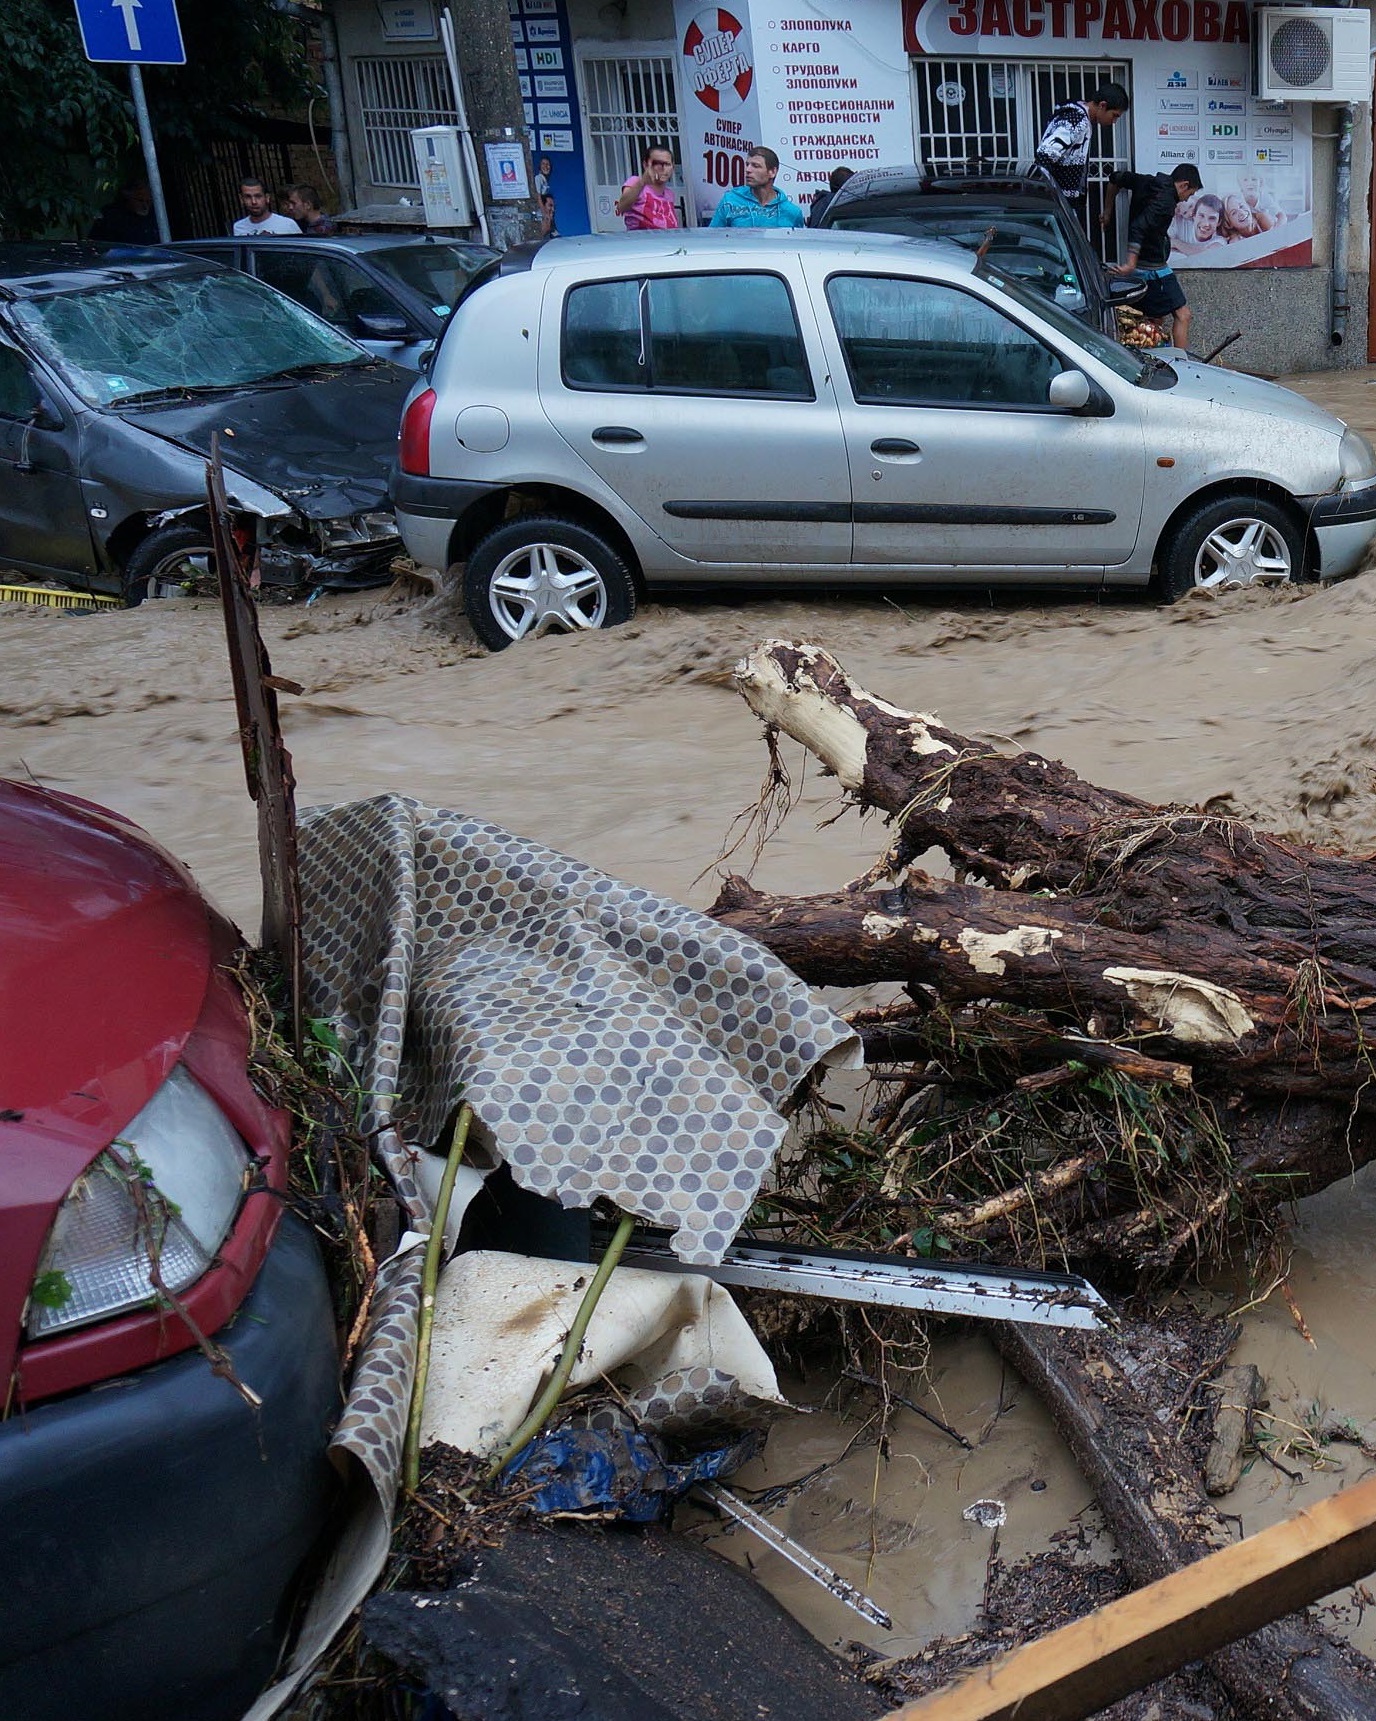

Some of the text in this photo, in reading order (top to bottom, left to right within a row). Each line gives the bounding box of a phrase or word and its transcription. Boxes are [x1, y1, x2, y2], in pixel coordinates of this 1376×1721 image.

[780, 19, 852, 31] ЗЛОПОЛУКА
[949, 0, 1303, 43] ЗАСТРАХОВА
[693, 30, 735, 66] СУПЕР
[782, 42, 820, 53] КАРГО
[536, 52, 558, 65] HDI
[694, 52, 750, 92] ОФЕРТА
[785, 64, 840, 77] ТРУДОВИ
[786, 78, 858, 90] ЗЛОПОЛУКИ
[788, 99, 895, 111] ПРОФЕСИОНАЛНИ
[789, 112, 881, 124] ОТГОВОРНОСТИ
[716, 118, 742, 135] СУПЕР
[1212, 124, 1238, 136] HDI
[704, 132, 754, 154] АВТОКАСКО
[793, 134, 875, 147] ГРАЖДАНСКА
[794, 148, 880, 160] ОТГОВОРНОСТ
